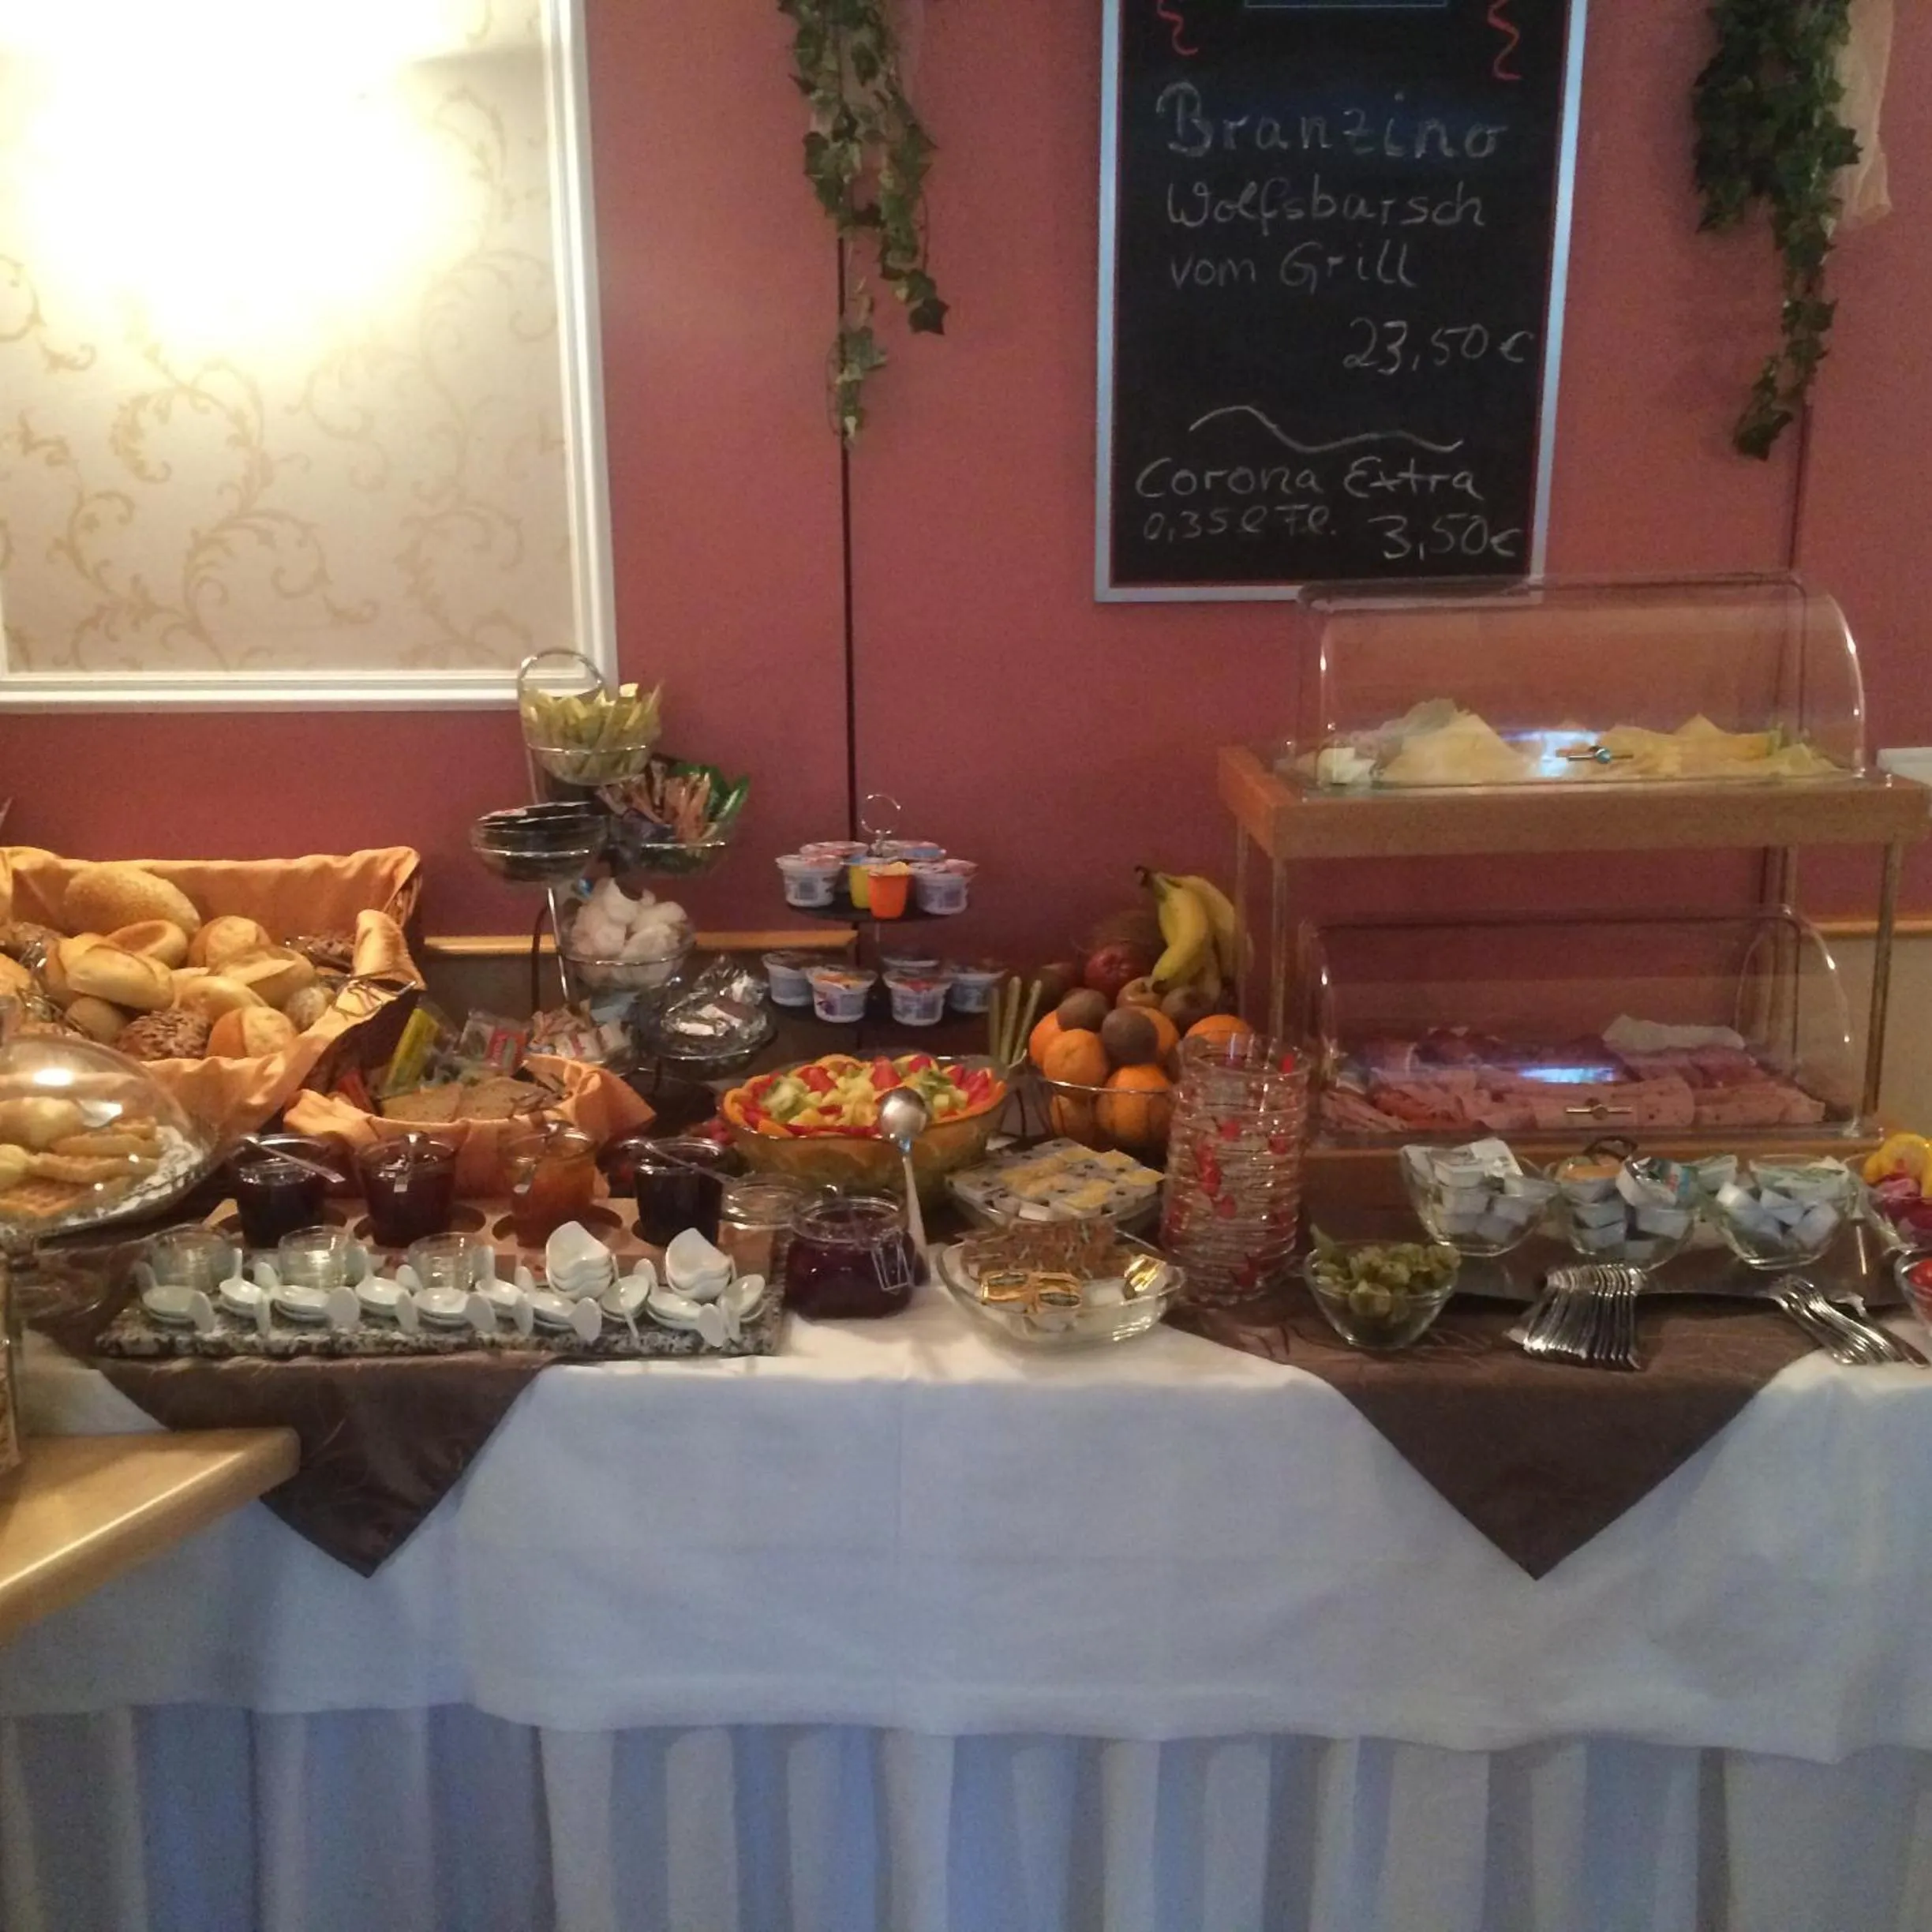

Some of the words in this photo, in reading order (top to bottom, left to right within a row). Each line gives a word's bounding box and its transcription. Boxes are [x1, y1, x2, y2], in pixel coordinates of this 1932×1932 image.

[1156, 80, 1509, 158] Branzino
[1170, 257, 1256, 289] vom
[1280, 240, 1418, 294] Grill
[1135, 458, 1324, 497] Corona
[1343, 456, 1485, 500] Extra
[1368, 515, 1521, 560] 3,50€
